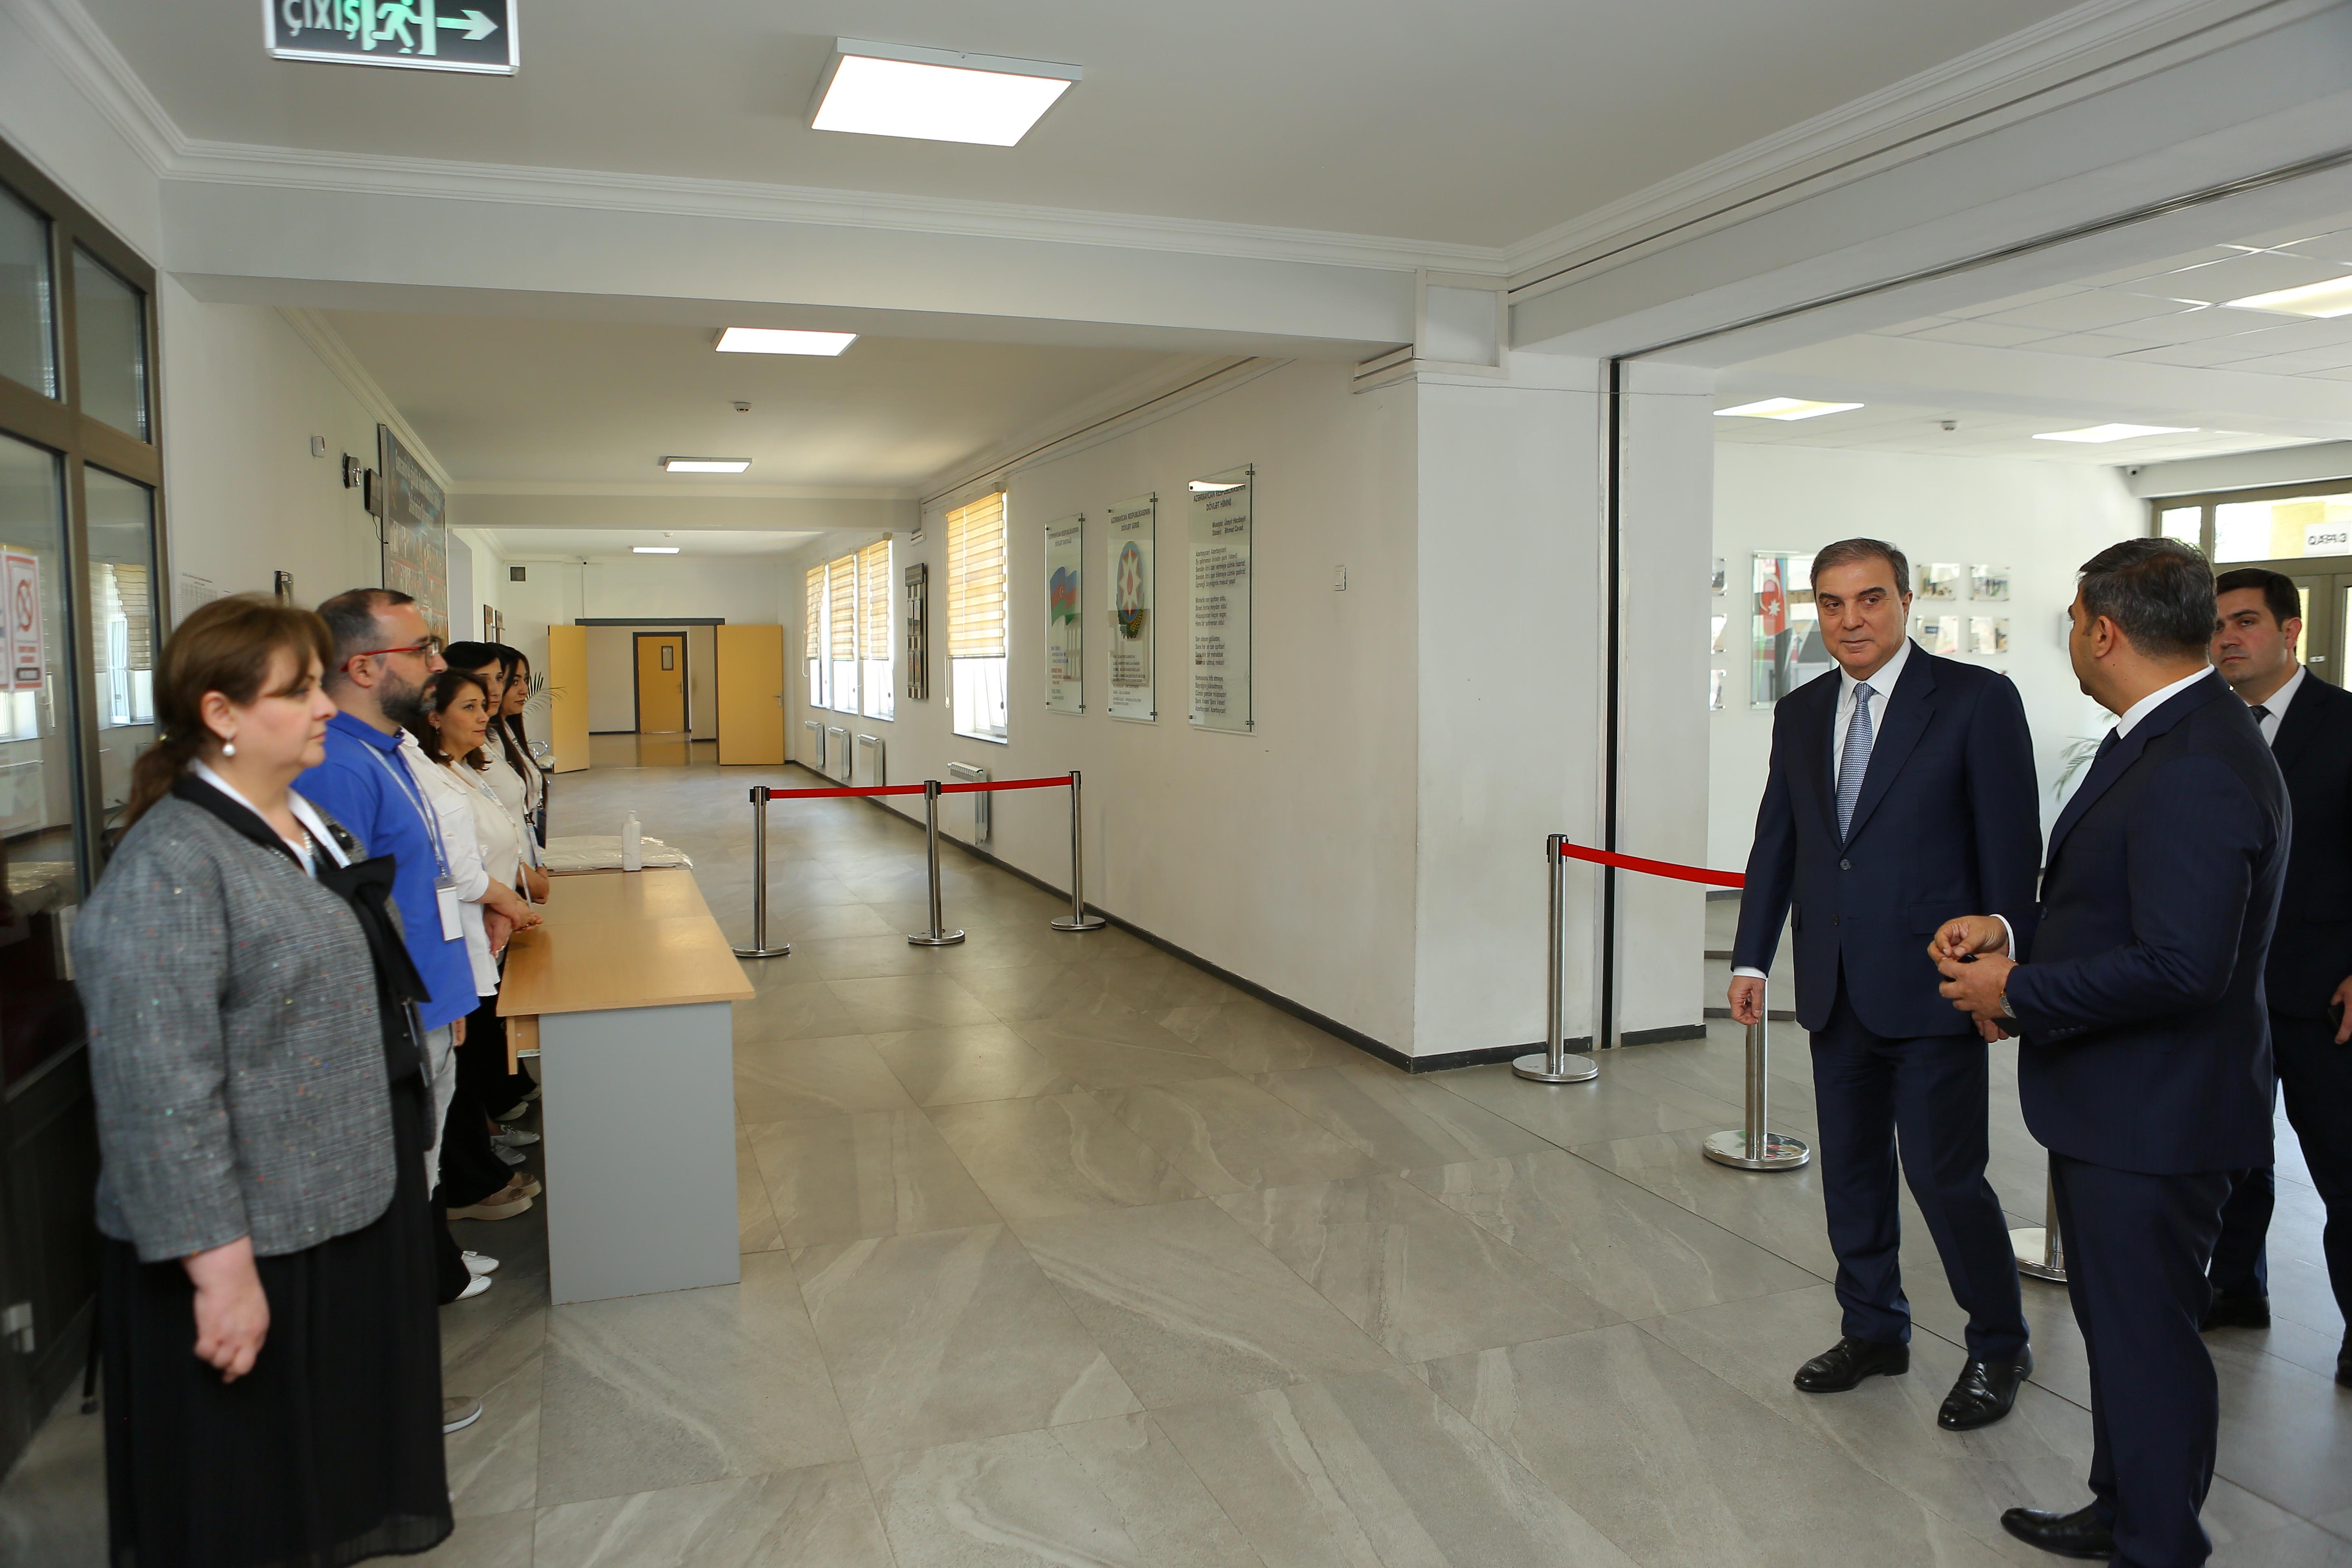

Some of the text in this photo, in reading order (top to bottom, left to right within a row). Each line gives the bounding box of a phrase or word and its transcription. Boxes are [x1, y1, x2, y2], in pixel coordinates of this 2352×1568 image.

[282, 0, 360, 40] ÇIXIŞ
[1206, 497, 1231, 511] DÖVLƏT HİMNİ
